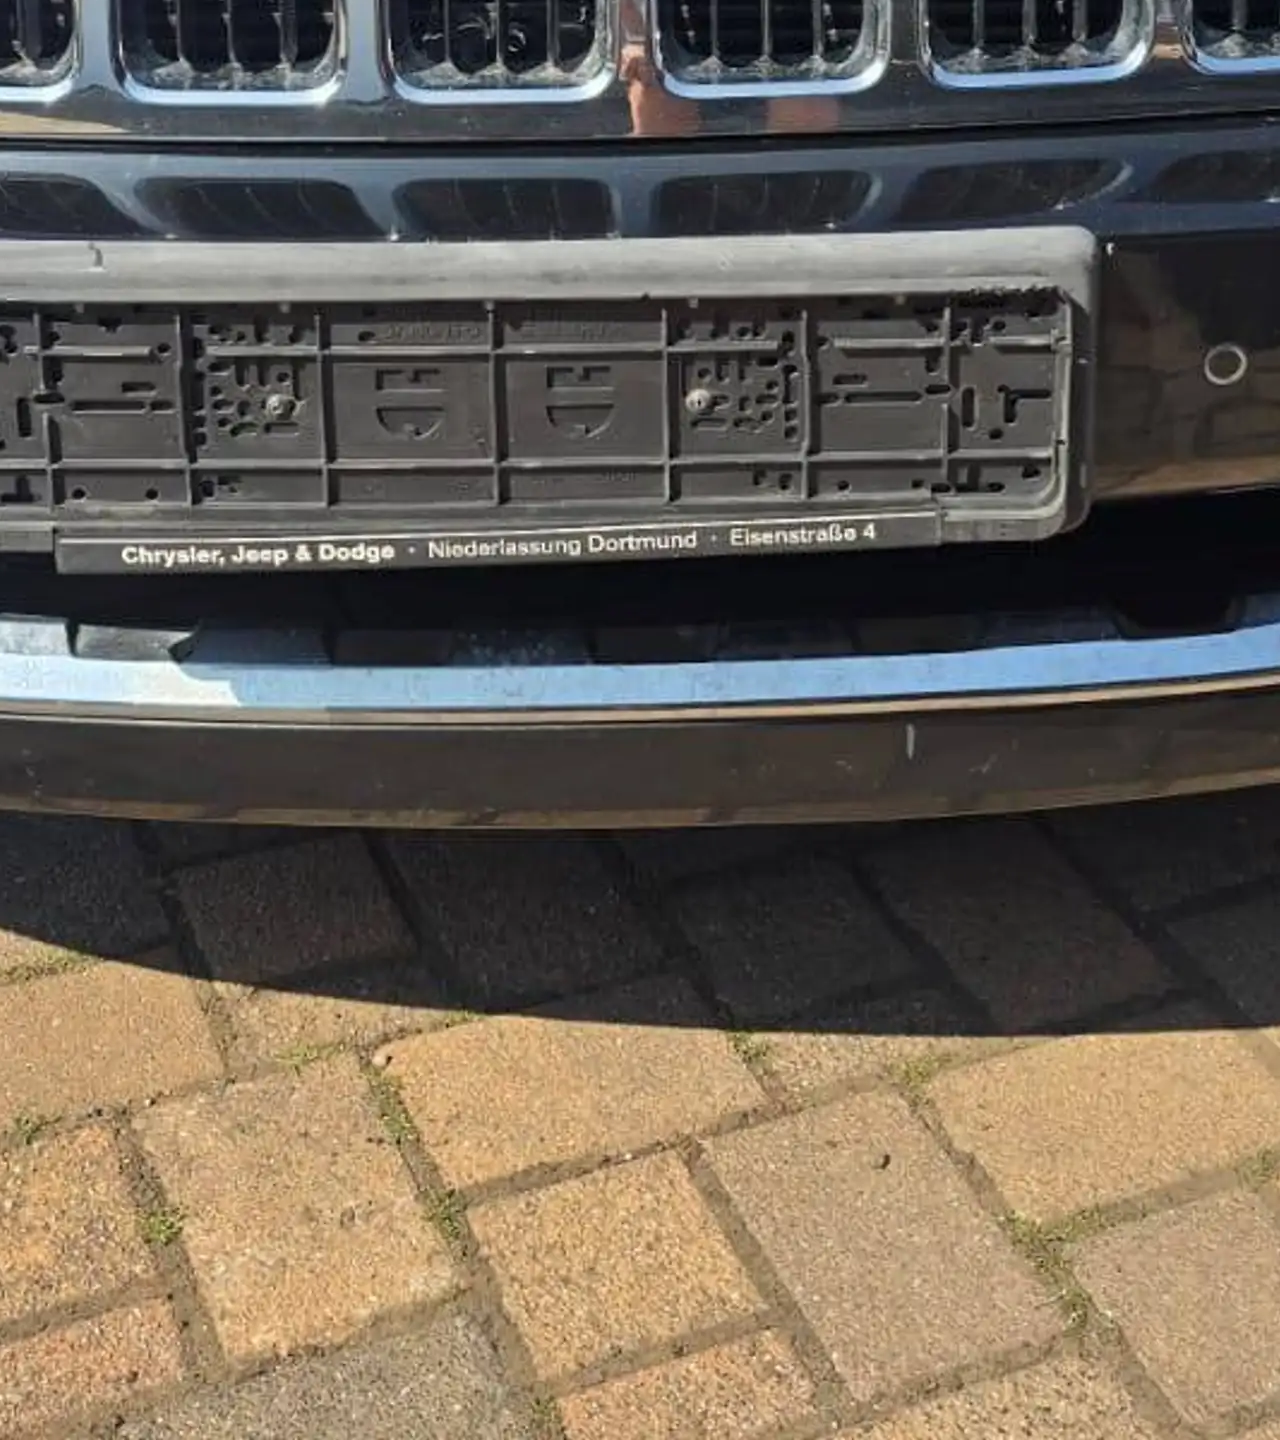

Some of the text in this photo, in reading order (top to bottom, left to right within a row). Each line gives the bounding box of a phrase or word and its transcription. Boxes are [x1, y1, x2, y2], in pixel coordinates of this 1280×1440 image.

[121, 522, 877, 568] Chrysler, Jeep & Dodge Niederlassung Dortmund Eisenstraße 4
